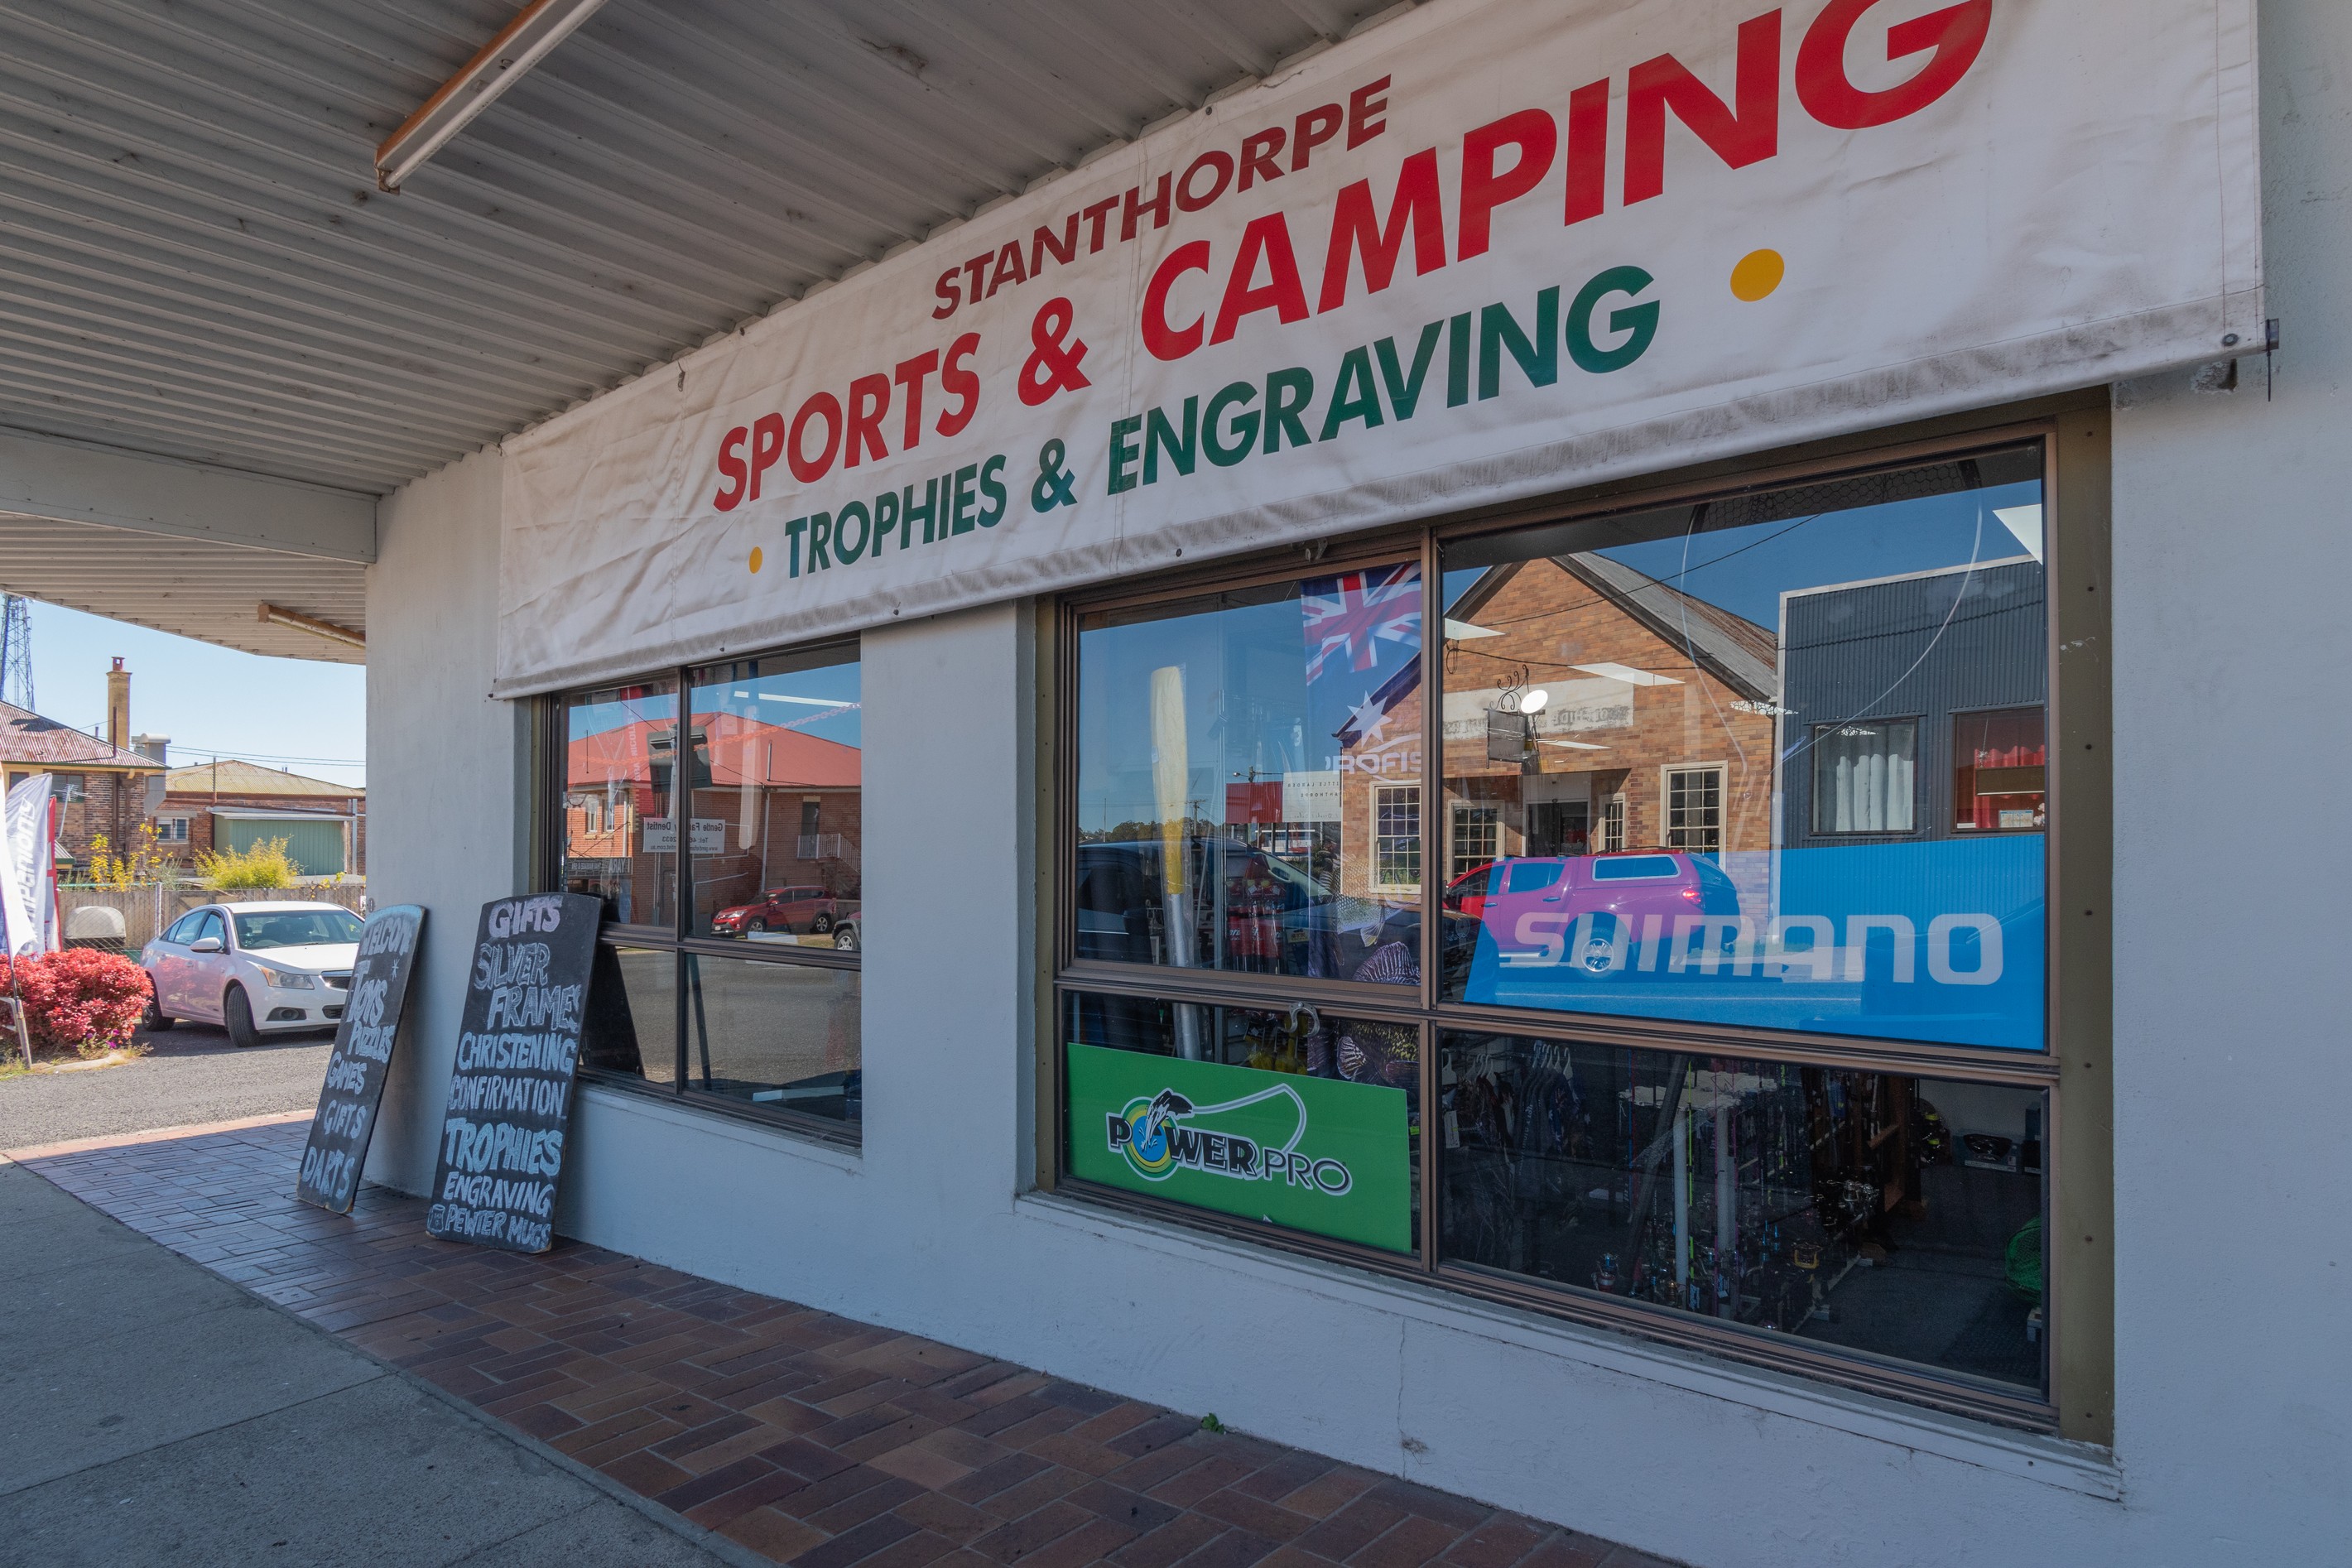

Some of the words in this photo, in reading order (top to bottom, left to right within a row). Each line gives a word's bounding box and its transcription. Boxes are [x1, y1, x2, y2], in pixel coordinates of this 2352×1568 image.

[931, 73, 1392, 320] STANTHORPE
[713, 332, 982, 512] SPORTS
[1017, 296, 1093, 407] &
[1141, 0, 1992, 362] CAMPING
[784, 454, 1008, 579] TROPHIES
[1030, 437, 1079, 514] &
[1108, 265, 1661, 497] ENGRAVING
[488, 895, 564, 938] GIFTS
[473, 941, 551, 990] SILVER
[487, 984, 582, 1034] FRAMES
[326, 1051, 368, 1095] GAMES
[457, 1031, 578, 1076] CHRISTENING
[323, 1099, 368, 1139] GIFTS
[448, 1074, 570, 1119] CONFIRMATION
[445, 1117, 564, 1176] TROPHIES
[301, 1146, 355, 1200] DARTS
[442, 1171, 556, 1218] ENGRAVING
[445, 1203, 507, 1239] PEWTER
[506, 1214, 552, 1248] MUGS
